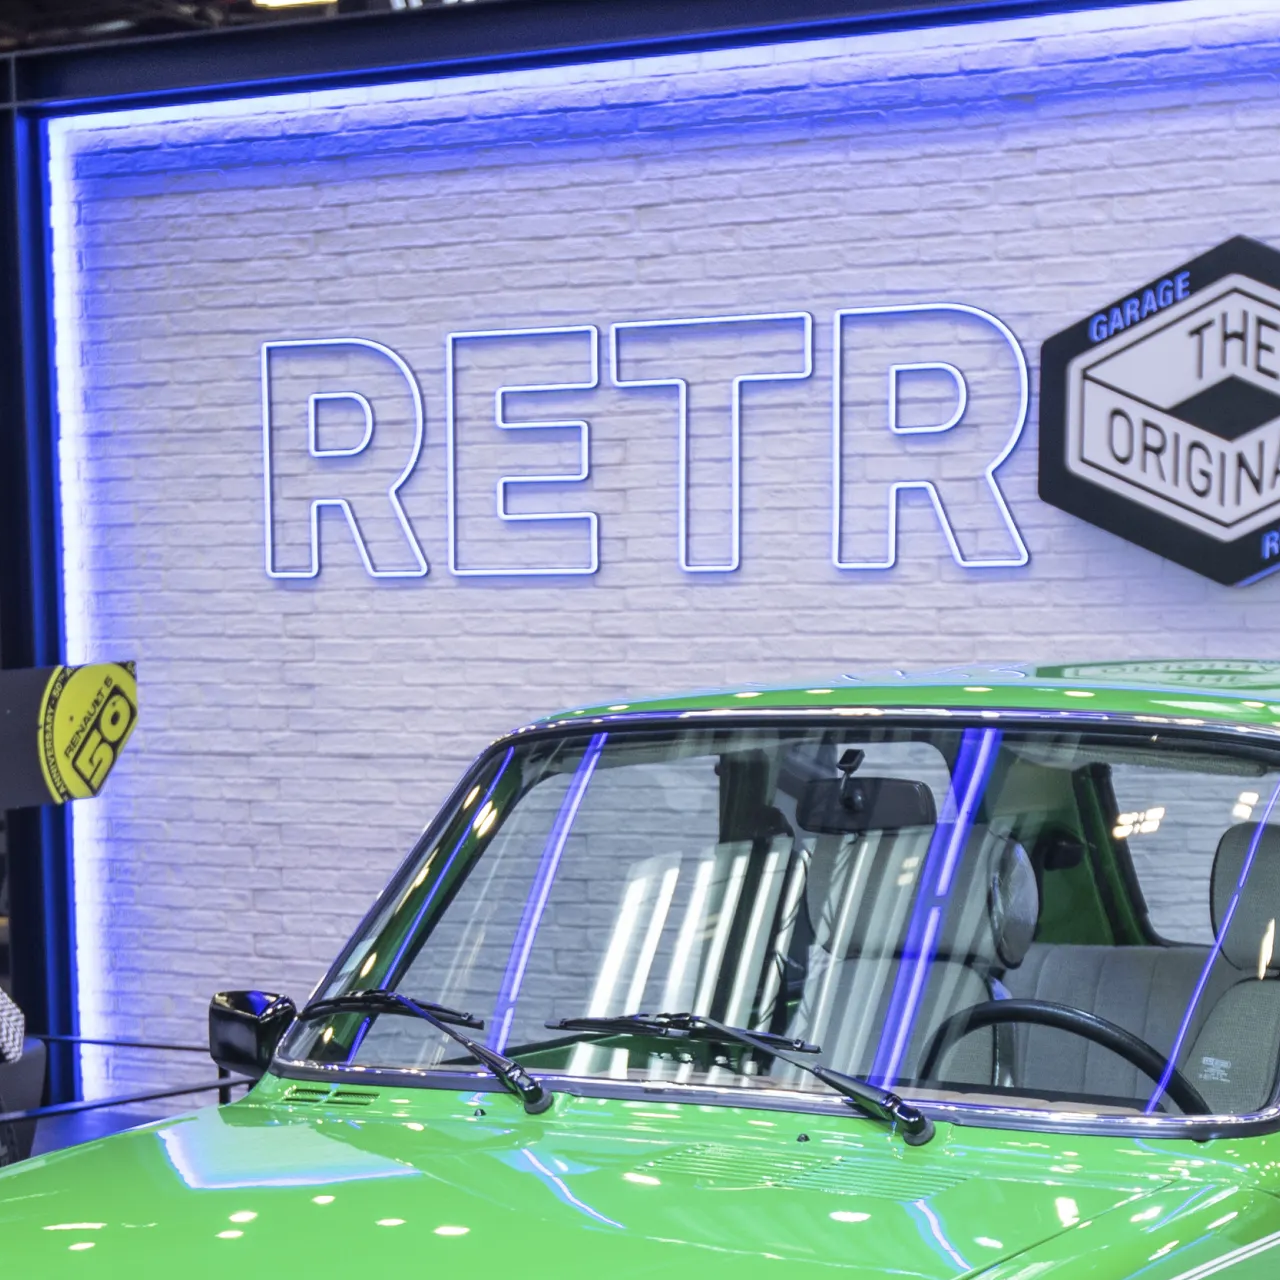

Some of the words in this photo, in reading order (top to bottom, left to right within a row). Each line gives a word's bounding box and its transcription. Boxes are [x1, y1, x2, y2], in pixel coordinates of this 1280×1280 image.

[1088, 270, 1190, 343] GARAGE
[45, 706, 67, 794] ANNIVERSARY
[64, 688, 105, 759] RENAULT
